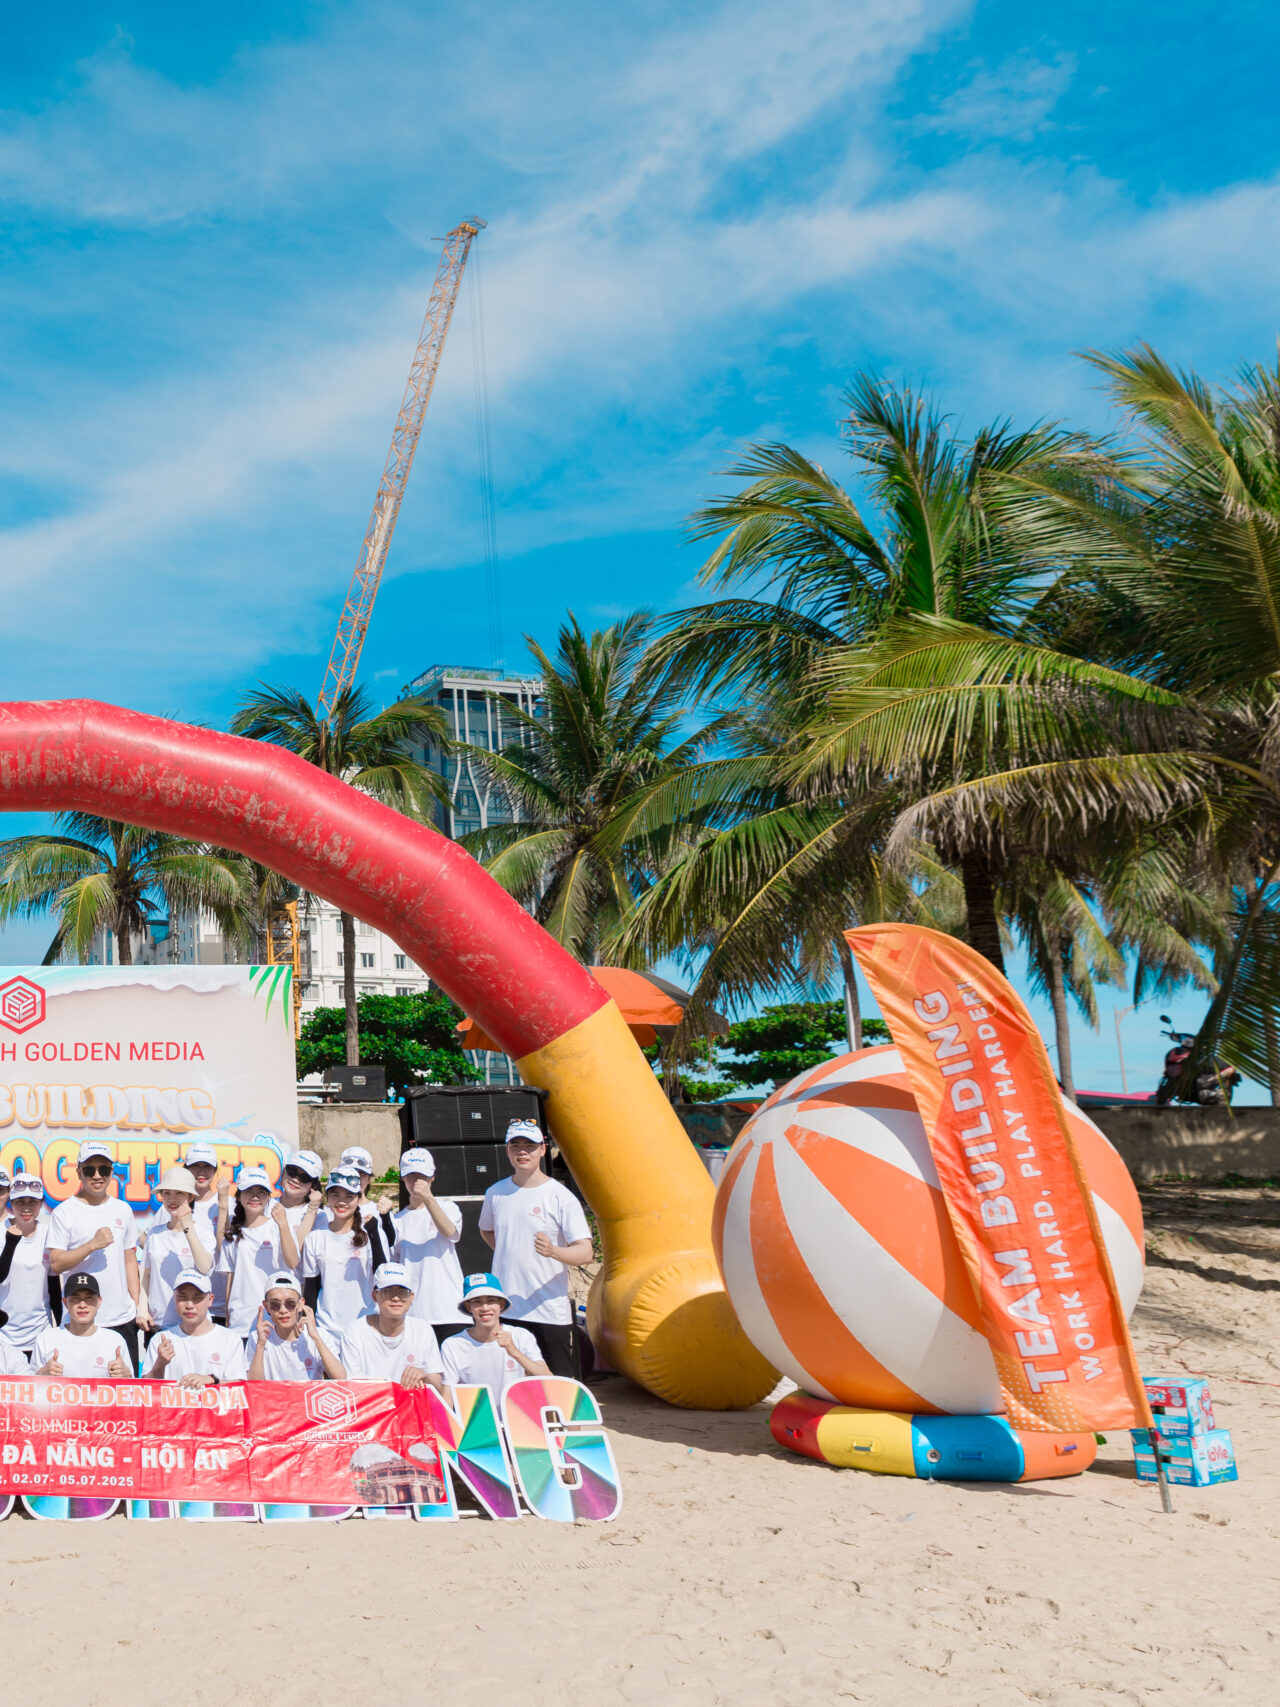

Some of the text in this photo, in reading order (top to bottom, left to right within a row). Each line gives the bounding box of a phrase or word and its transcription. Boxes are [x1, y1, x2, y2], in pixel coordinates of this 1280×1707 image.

[25, 1042, 120, 1062] GOLDEN
[129, 1041, 205, 1061] MEDIA
[913, 989, 1069, 1394] TEAM BUILDING
[957, 981, 1105, 1382] WORK HARD, PLAY HARDER!
[77, 1275, 88, 1285] H
[46, 1382, 153, 1408] GOLDEN
[161, 1385, 249, 1410] MEDIA
[20, 1417, 89, 1435] SUMMER
[94, 1420, 138, 1435] 2025
[2, 1439, 37, 1466] ĐÀ
[141, 1442, 185, 1474] HỘI
[194, 1448, 229, 1470] AN
[59, 1474, 134, 1487] 05.07.2025
